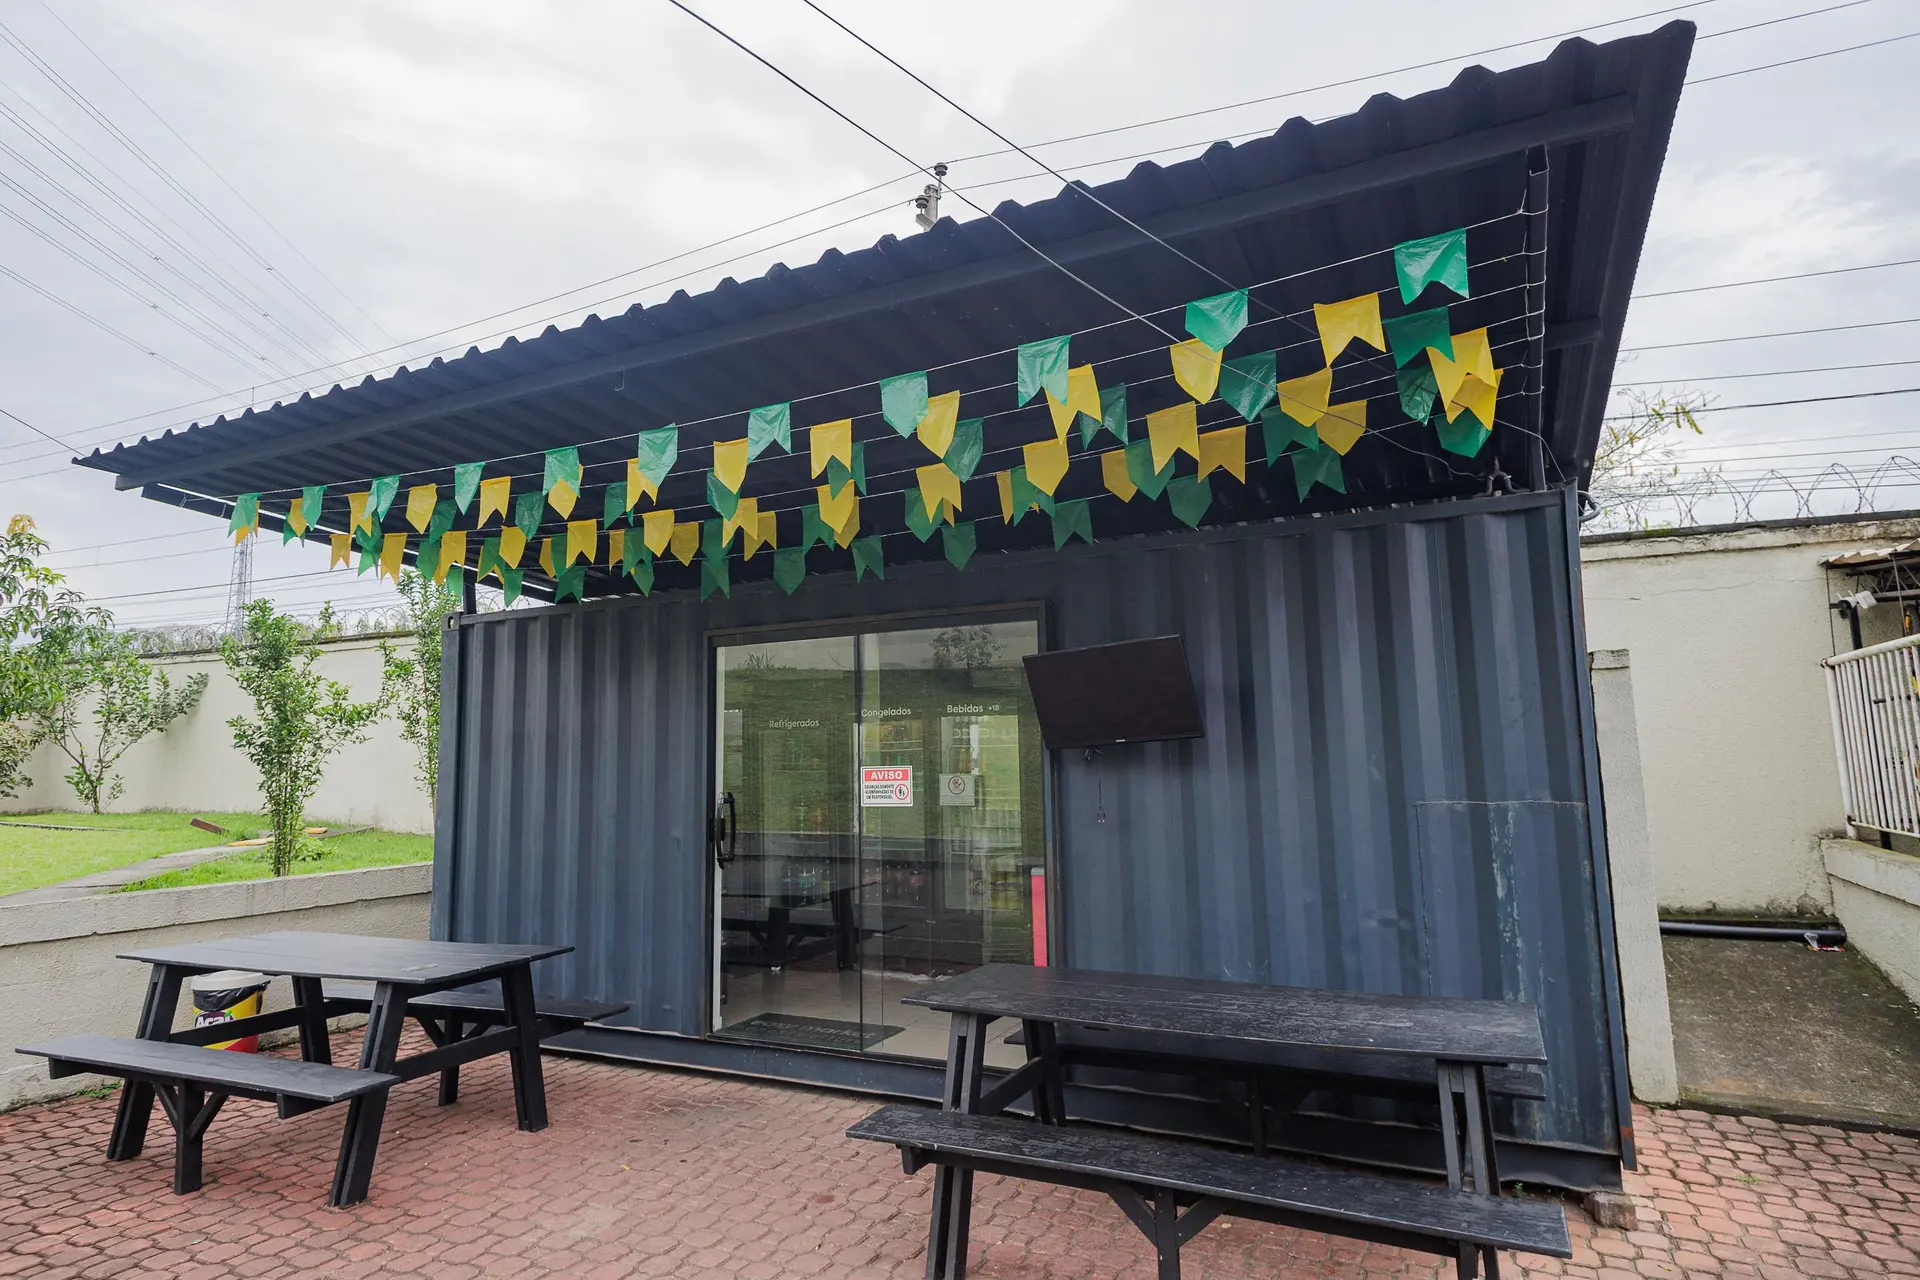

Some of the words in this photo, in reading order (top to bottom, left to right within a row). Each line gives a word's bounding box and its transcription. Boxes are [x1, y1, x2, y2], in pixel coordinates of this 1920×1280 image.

[861, 708, 912, 719] Congelados
[947, 704, 983, 714] Bebidas
[769, 719, 820, 730] Refrigerados
[870, 770, 903, 780] AVISO
